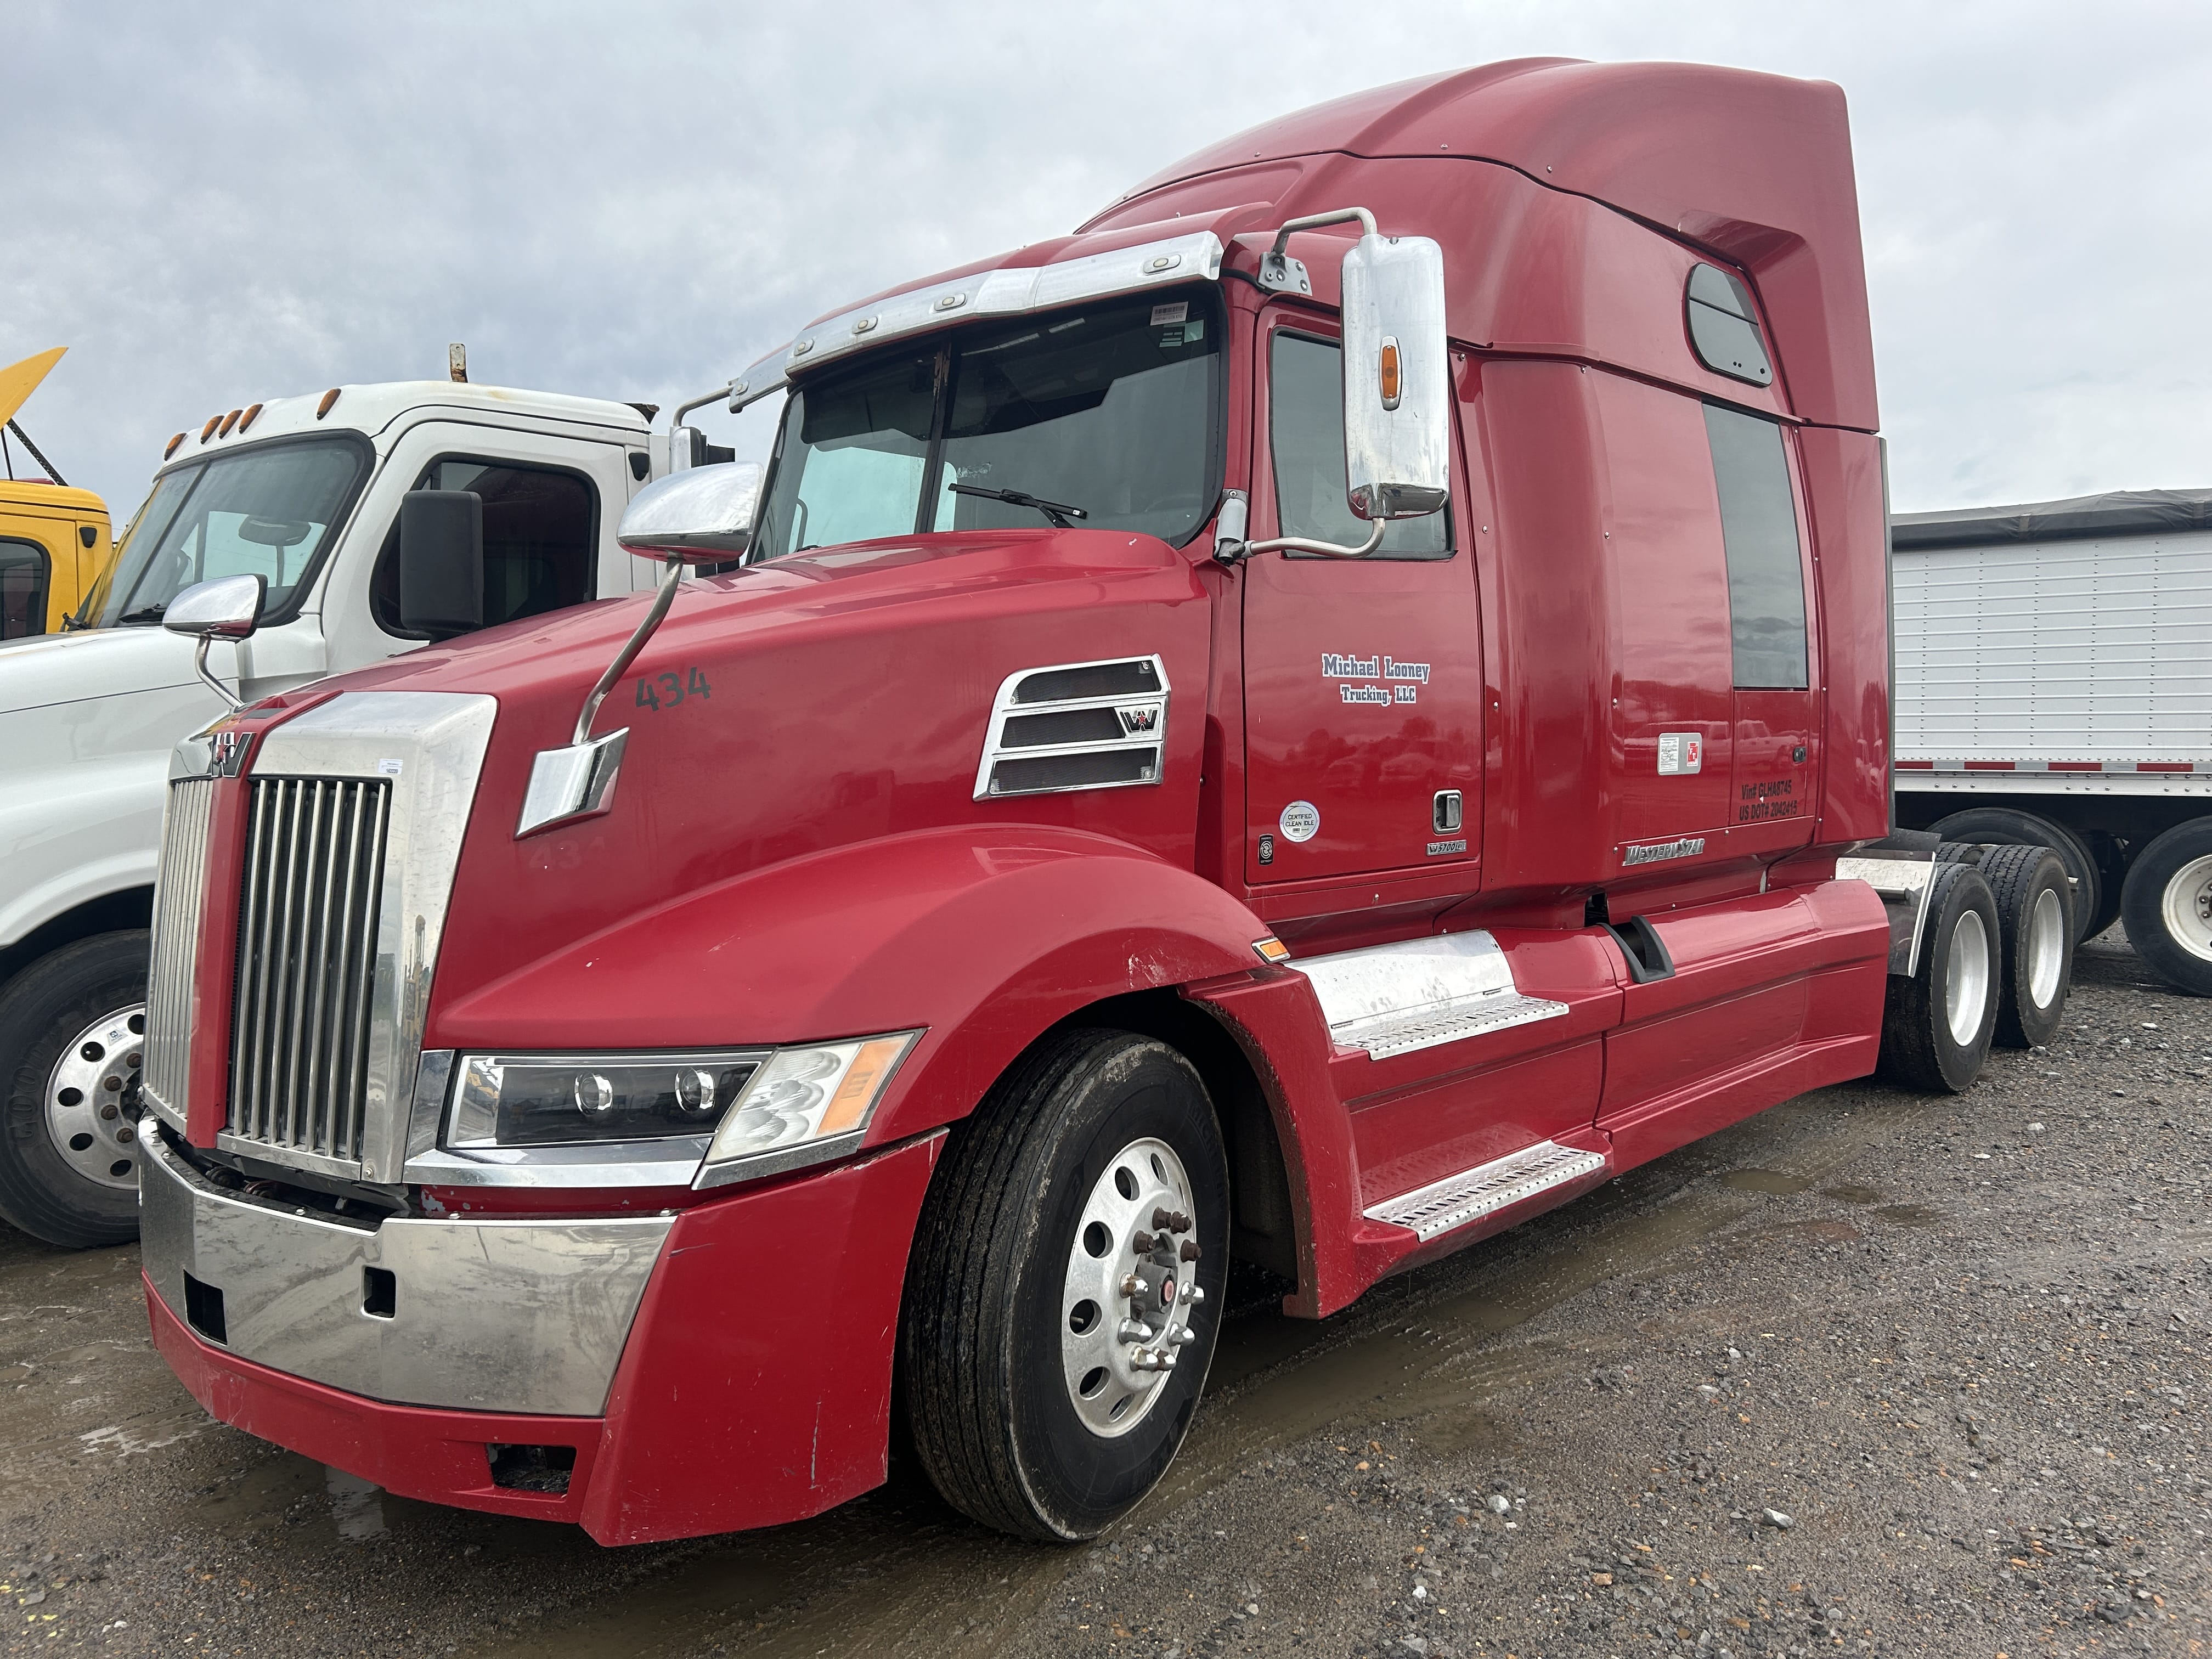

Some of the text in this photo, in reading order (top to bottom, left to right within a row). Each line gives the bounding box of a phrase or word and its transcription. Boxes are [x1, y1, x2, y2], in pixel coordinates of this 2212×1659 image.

[1322, 654, 1429, 684] Michael Looney
[635, 667, 712, 712] 434
[1341, 685, 1415, 706] Trucking, LLC
[1739, 804, 1750, 821] US
[1751, 803, 1770, 820] DOT#
